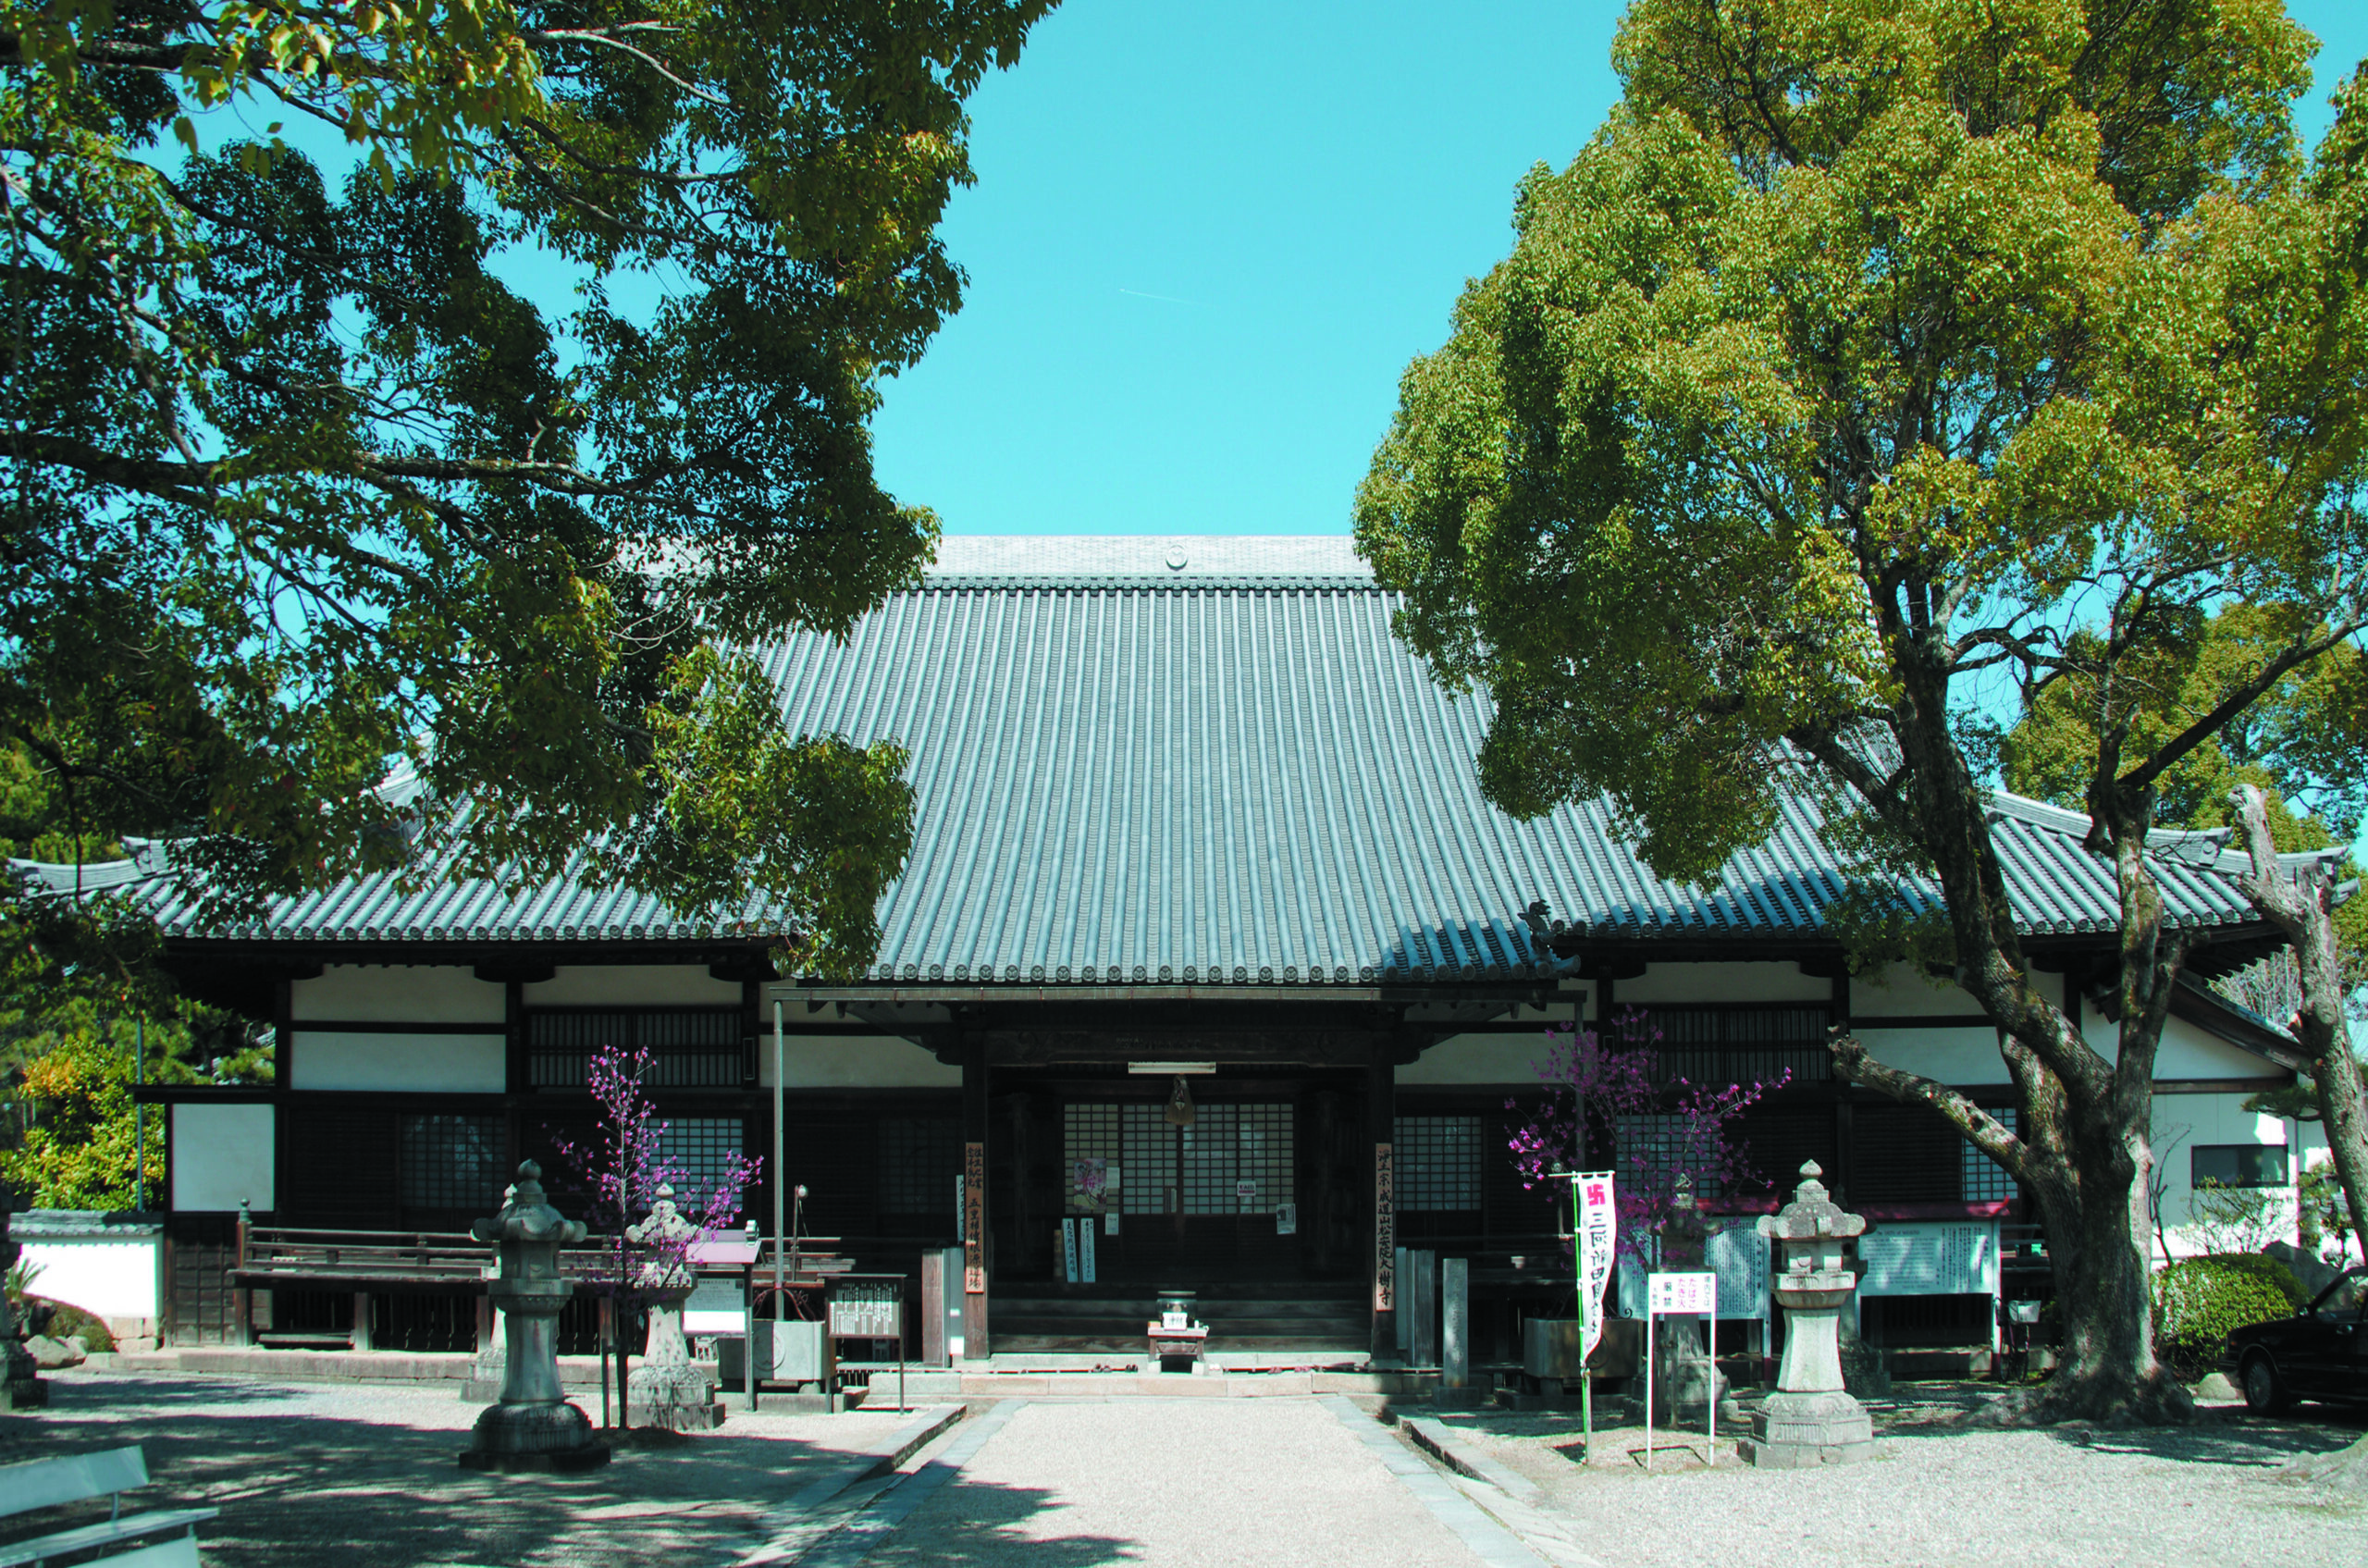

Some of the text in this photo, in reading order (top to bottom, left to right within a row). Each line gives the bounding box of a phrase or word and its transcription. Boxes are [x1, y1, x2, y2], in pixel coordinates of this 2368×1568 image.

[1664, 1281, 1672, 1307] 厳禁
[1678, 1278, 1686, 1308] たき火
[1688, 1278, 1696, 1308] たばこ
